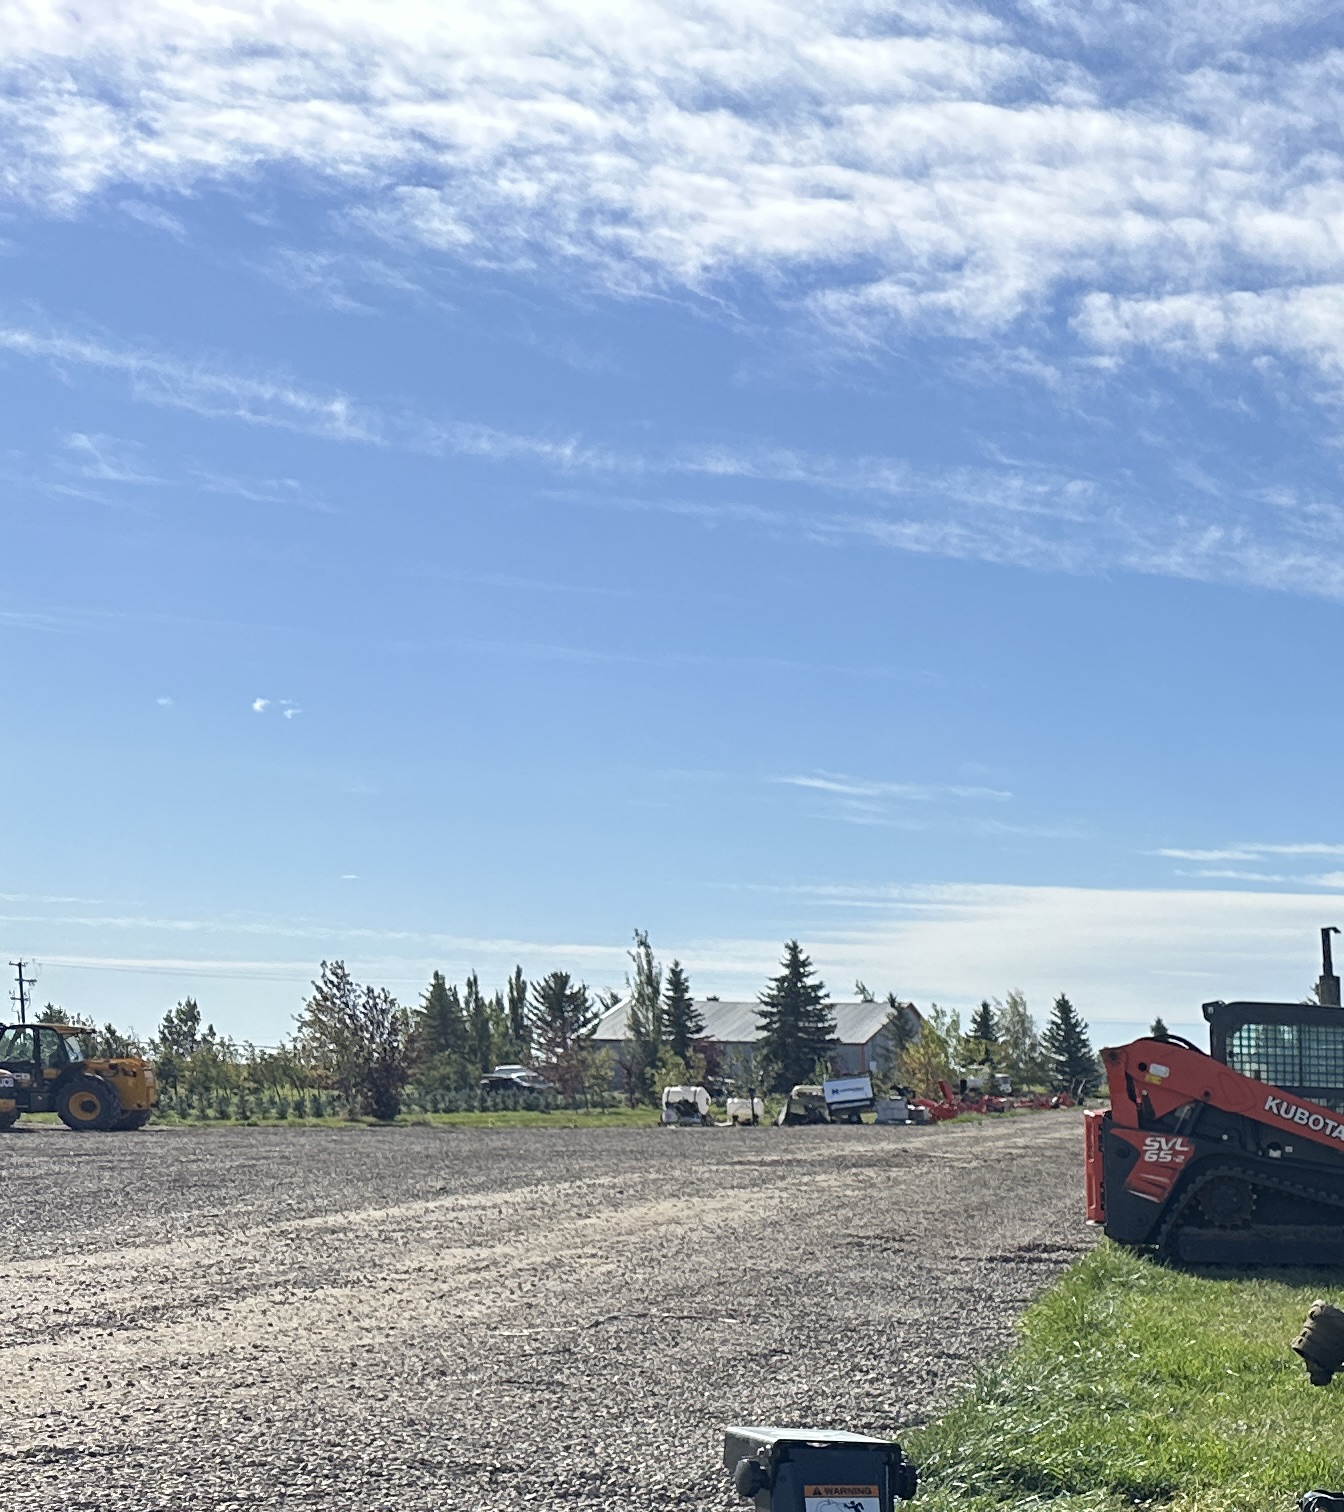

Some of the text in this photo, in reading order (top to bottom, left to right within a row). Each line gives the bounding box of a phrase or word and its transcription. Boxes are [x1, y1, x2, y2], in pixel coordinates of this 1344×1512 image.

[12, 1072, 31, 1080] CB
[1143, 1137, 1190, 1150] SVL
[1144, 1150, 1185, 1163] 65-2
[824, 1487, 872, 1495] WARNING
